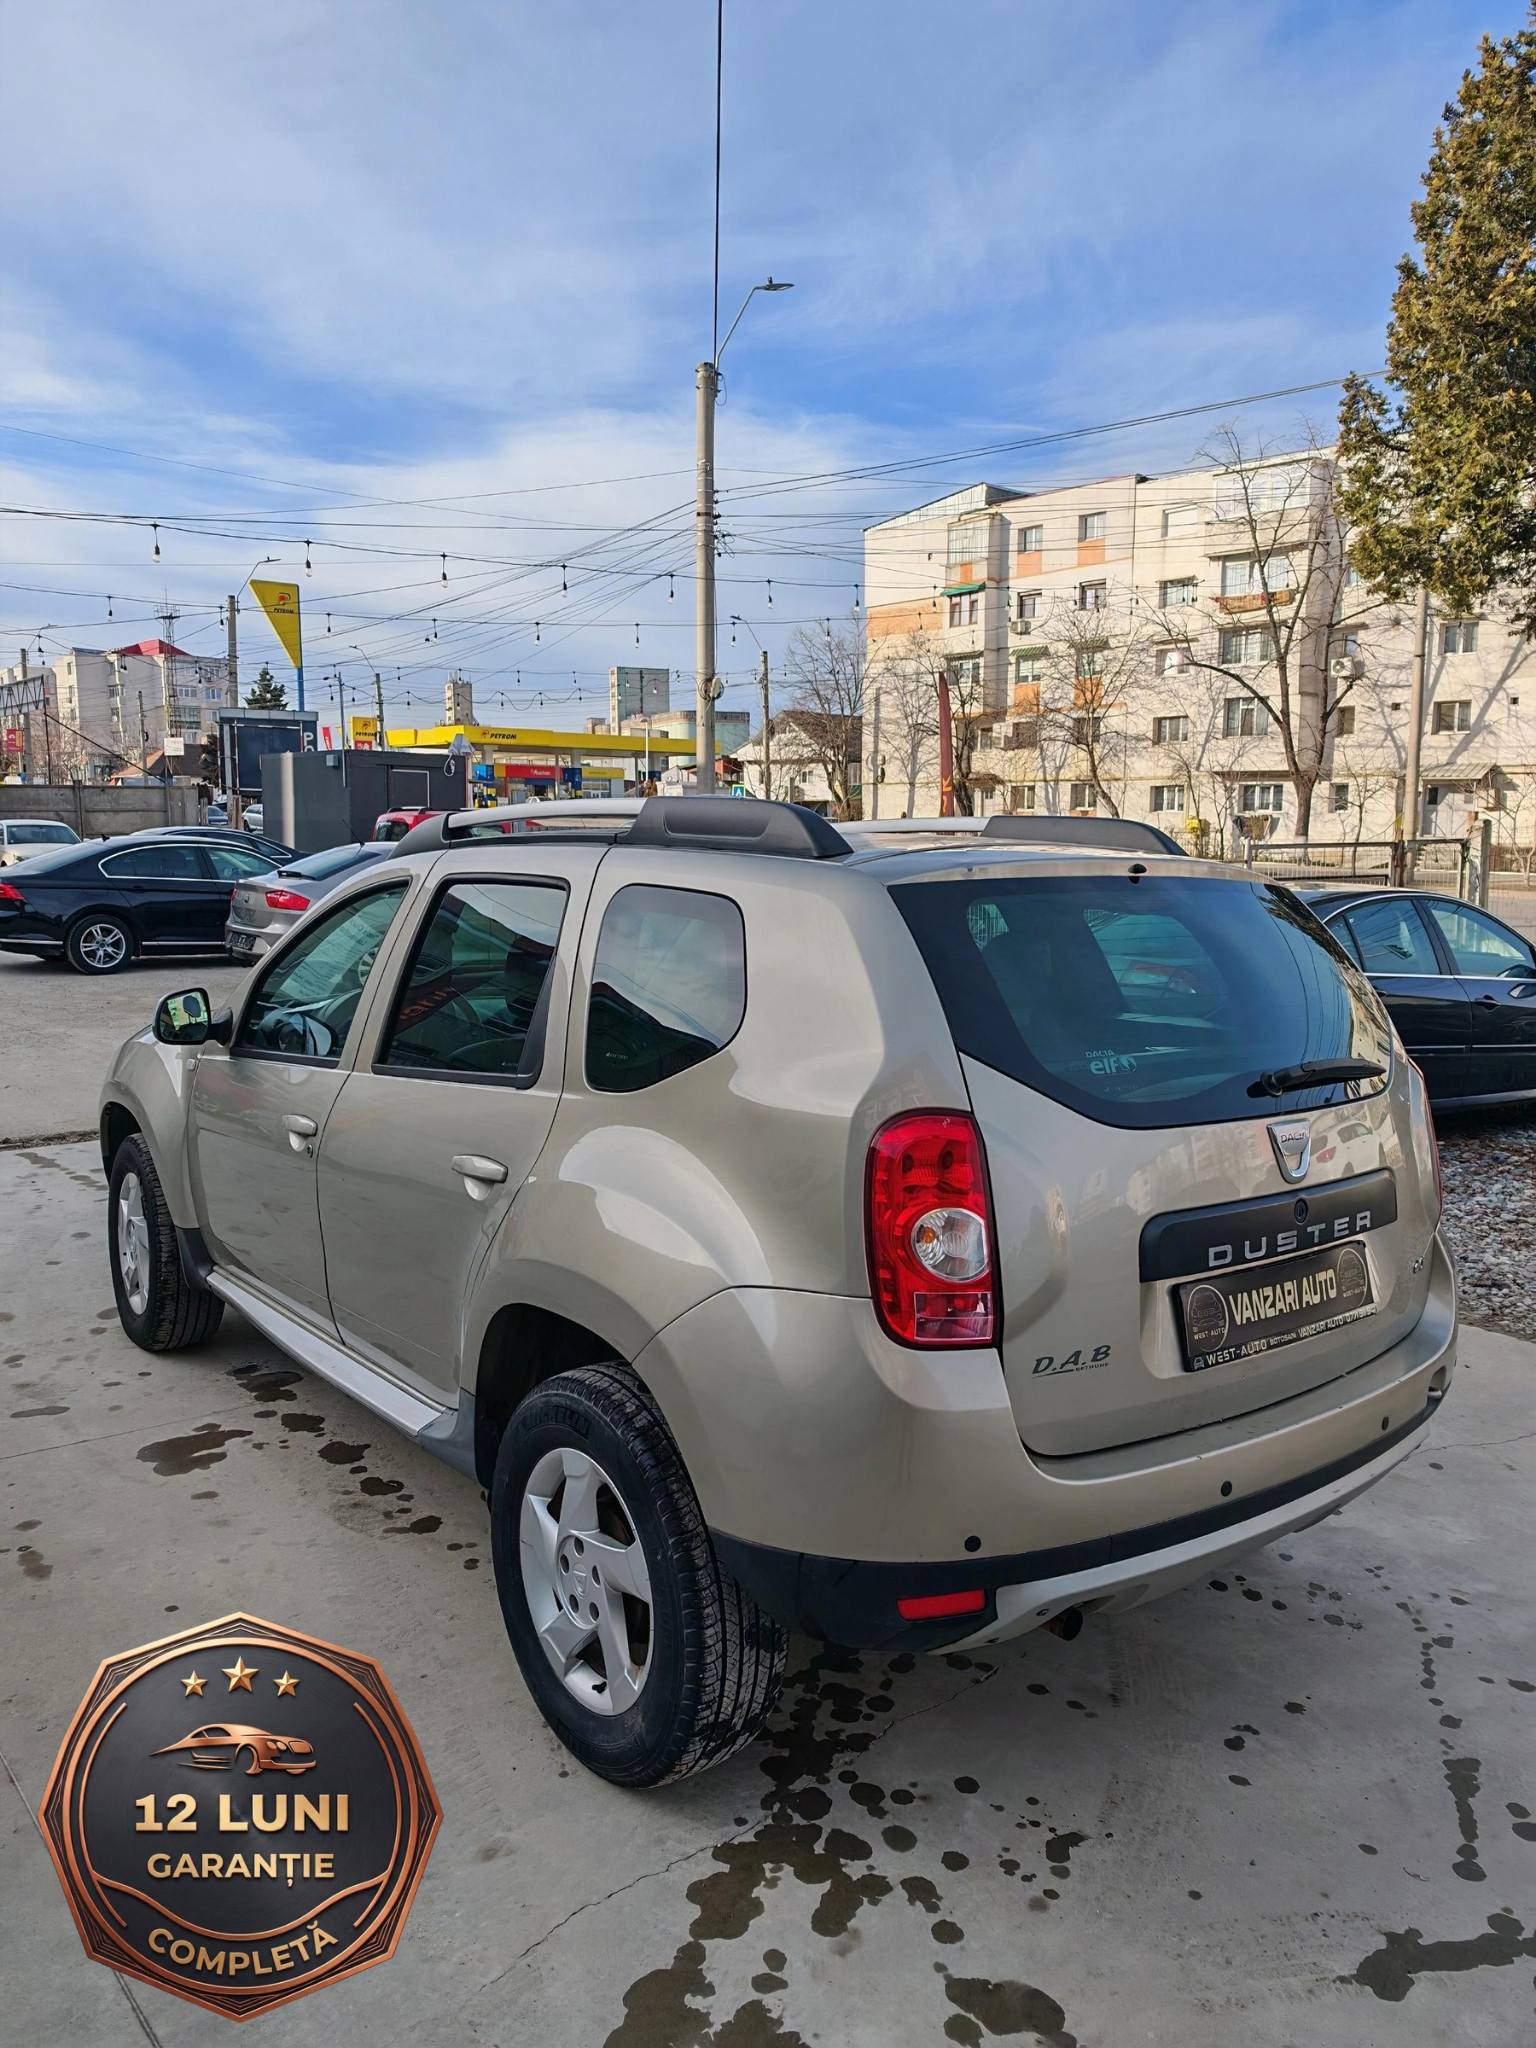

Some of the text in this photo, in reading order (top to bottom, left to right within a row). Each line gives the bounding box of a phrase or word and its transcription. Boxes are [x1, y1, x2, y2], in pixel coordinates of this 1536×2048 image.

[490, 732, 517, 740] PETROM
[1090, 1056, 1119, 1074] elf
[1208, 1210, 1371, 1267] DUSTER
[1229, 1268, 1337, 1326] VANZARI AUTO
[1206, 1340, 1267, 1366] WEST-AUTO
